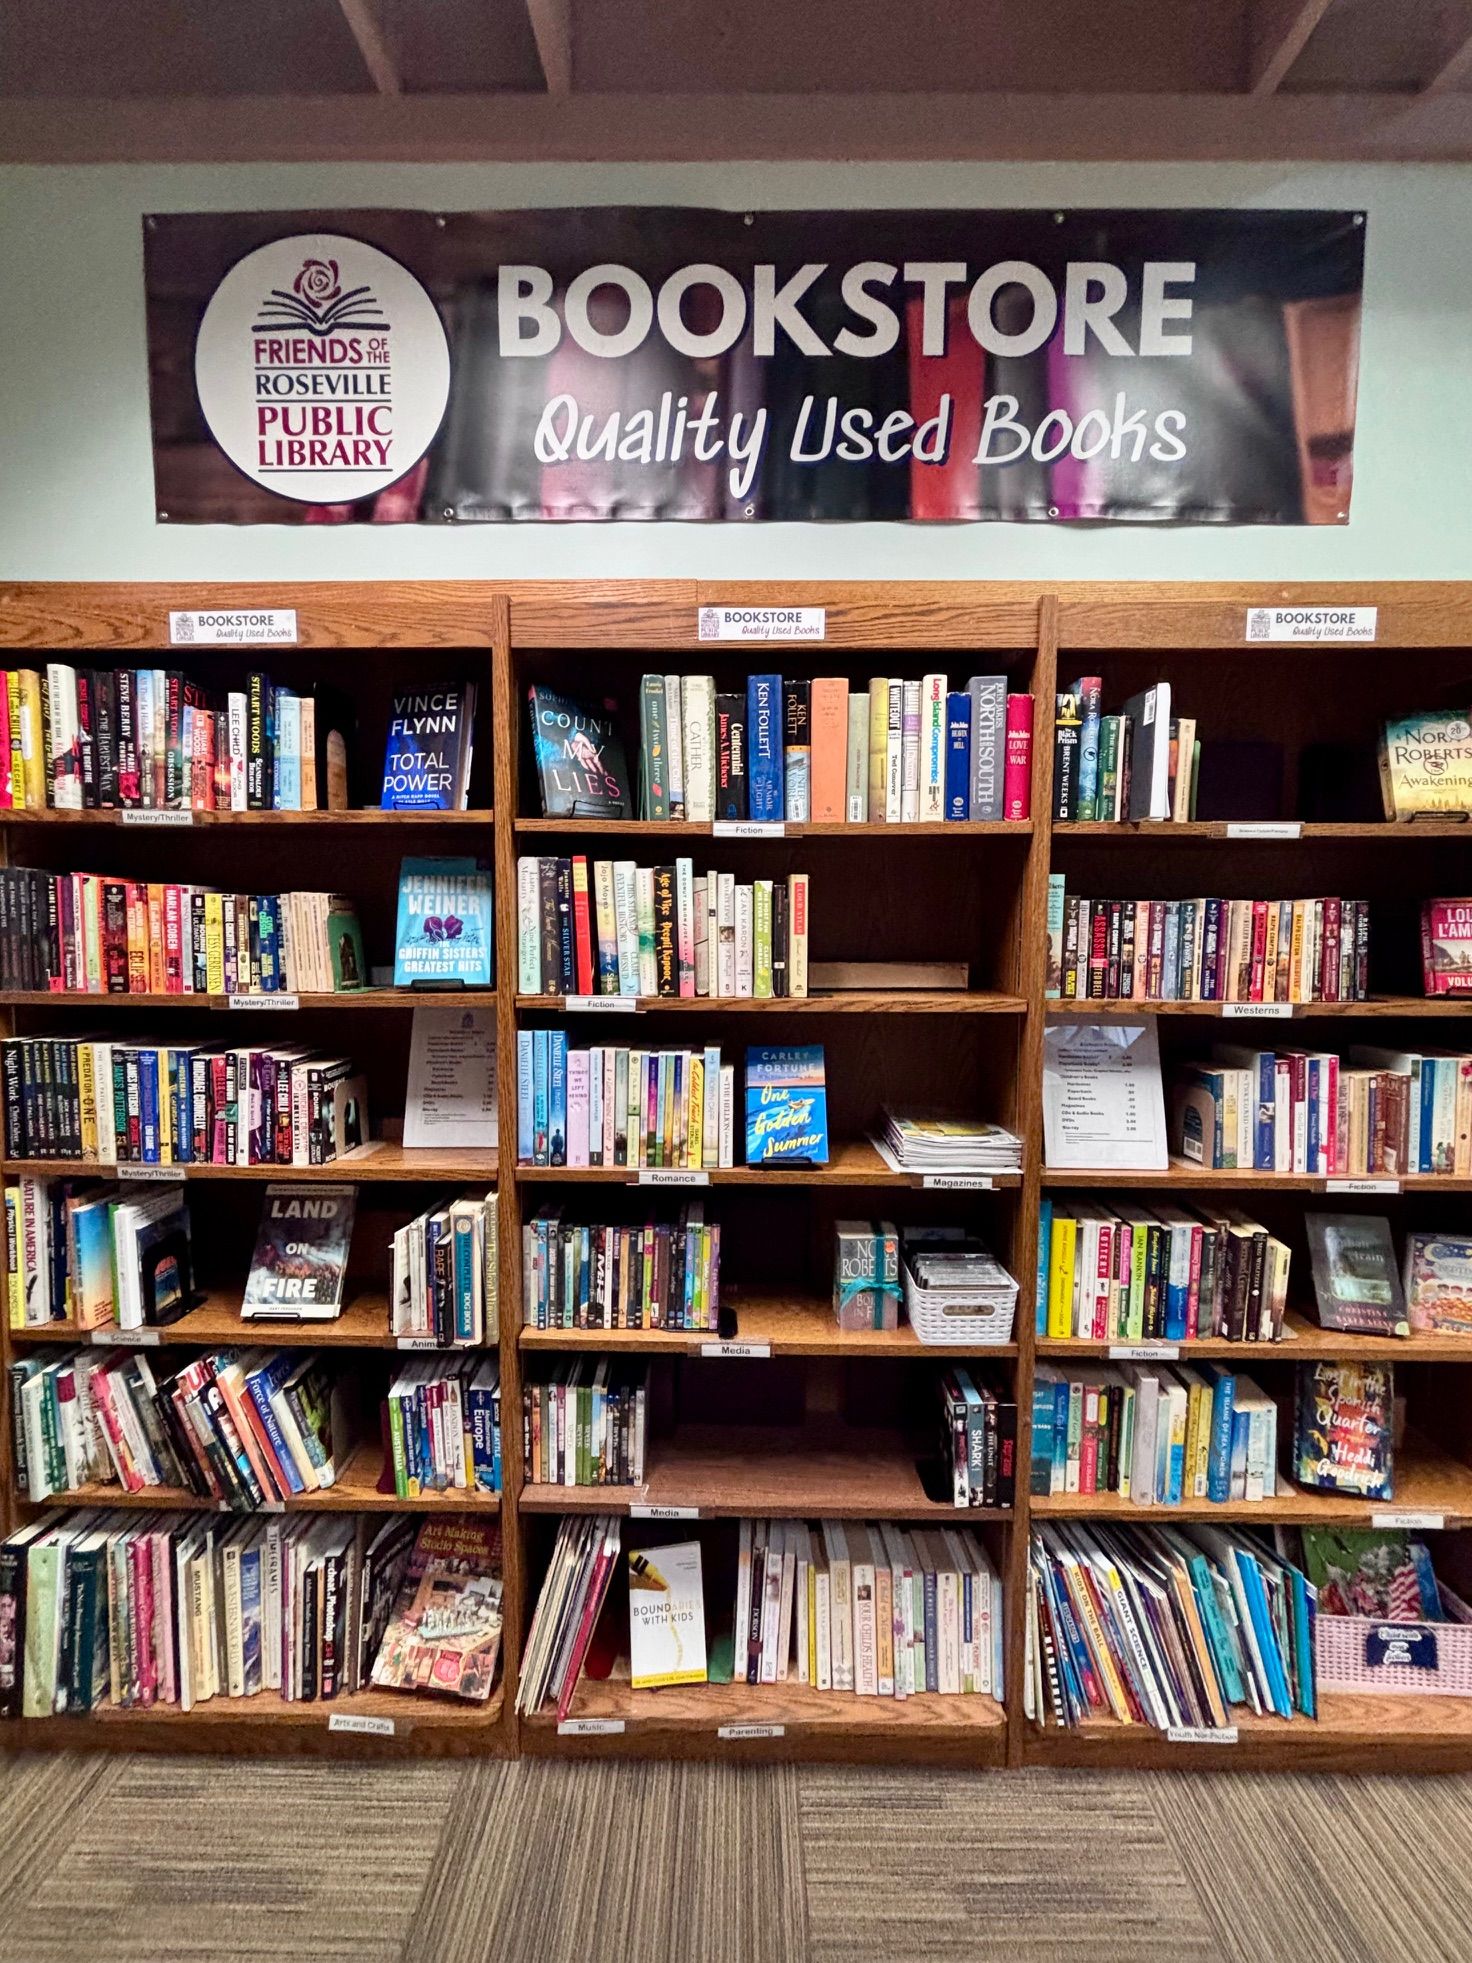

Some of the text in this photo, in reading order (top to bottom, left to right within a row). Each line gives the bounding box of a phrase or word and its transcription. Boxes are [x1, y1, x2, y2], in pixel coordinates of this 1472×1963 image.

[498, 260, 1196, 358] BOOKSTORE
[254, 338, 388, 364] FRIENDS OF
[367, 351, 390, 364] THE
[255, 374, 392, 395] ROSEVILLE
[258, 405, 393, 436] PUBLIC
[258, 439, 393, 467] LIBRARY
[534, 391, 1187, 499] Quality Used Books
[199, 616, 274, 626] BOOKSTORE
[725, 612, 802, 622] BOOKSTORE
[1276, 613, 1356, 624] BOOKSTORE
[216, 628, 291, 640] Quality Used Books
[742, 626, 770, 638] Quality
[795, 626, 819, 634] Books
[1293, 626, 1372, 638] Quality Used Books
[120, 673, 130, 737] STEVE BERRY
[170, 678, 178, 711] STUART
[393, 693, 458, 714] VINCE
[890, 687, 900, 728] WHITEOUT
[231, 709, 239, 725] LEE
[251, 676, 260, 753] STUART WOODS
[391, 716, 456, 736] FLYNN
[719, 713, 729, 738] James
[758, 683, 771, 758] KEN FOLLETT
[787, 694, 806, 735] KEN FOLLETT
[652, 701, 662, 783] one three
[930, 679, 942, 784] Long Island Compromise
[979, 685, 995, 803] NORTH SOUTH
[1058, 730, 1077, 738] Black
[690, 721, 702, 771] CATHER
[731, 723, 743, 775] Centennial
[391, 752, 449, 770] TOTAL
[1061, 746, 1071, 803] BRENT WEEKS
[383, 773, 452, 792] POWER
[553, 769, 621, 798] LIES
[126, 812, 189, 822] Mystery/Thriller
[402, 876, 488, 894] JENNIFER
[600, 865, 608, 882] Jojo
[408, 895, 481, 915] WEINER
[166, 890, 177, 949] HARLAN COBEN
[399, 948, 485, 960] GRIFFIN SISTERS
[562, 928, 570, 955] SILVER
[129, 951, 145, 984] ECLIPSE
[208, 934, 221, 991] TESS GERRITSEN
[404, 961, 455, 972] GREATEST
[1093, 968, 1101, 997] TED BELL
[233, 998, 295, 1007] Mystery/Thriller
[588, 1001, 615, 1009] Fiction
[1234, 1006, 1280, 1014] Westerns
[521, 1041, 529, 1077] DANIELLE
[553, 1035, 563, 1067] DANIELLE
[761, 1051, 810, 1061] CARLEY
[5, 1050, 20, 1101] Night Work
[756, 1063, 814, 1074] FORTUNE
[82, 1053, 95, 1124] PREDATOR ONE
[114, 1065, 126, 1132] JAMES PATTERSON
[127, 1063, 139, 1116] JAMES PATTERSON
[193, 1061, 206, 1129] MICHAEL CONNELLY
[278, 1080, 289, 1112] LEE CHILD
[760, 1085, 790, 1105] One
[754, 1108, 812, 1135] Golden
[765, 1132, 824, 1158] Summer
[121, 1169, 182, 1178] Mystery/Thriller
[652, 1174, 696, 1183] Romance
[933, 1178, 983, 1188] Magazines
[270, 1200, 339, 1218] LAND
[24, 1179, 36, 1272] NATURE IN AMERICA
[7, 1208, 17, 1272] Physics Workbook
[285, 1243, 310, 1255] ON
[486, 1242, 496, 1260] The
[1099, 1229, 1108, 1274] LOTTERY
[436, 1249, 445, 1276] RARE
[262, 1278, 317, 1299] FIRE
[721, 1346, 750, 1355] Media
[1131, 1350, 1158, 1358] Fiction
[250, 1378, 282, 1446] Force of Nature
[1328, 1387, 1381, 1414] Spanish
[473, 1409, 484, 1449] Europe
[1222, 1423, 1229, 1432] OF
[1316, 1407, 1382, 1435] Quarter
[393, 1431, 402, 1471] AUSTRALIA
[971, 1430, 982, 1467] SHARK
[1331, 1442, 1376, 1467] Heddi
[1219, 1450, 1227, 1477] WOMEN
[1316, 1461, 1387, 1488] Goodrich
[650, 1509, 679, 1517] Media
[420, 1538, 453, 1551] Studio
[424, 1524, 485, 1543] Art Making
[193, 1570, 202, 1616] MUSTANG
[324, 1568, 337, 1641] cheat Photoshop
[642, 1612, 694, 1625] WITH KIDS
[1074, 1572, 1104, 1648] KIDS ON THE BALL
[751, 1607, 761, 1641] DOBSON
[1117, 1591, 1148, 1670] GIANT SCIENCE
[861, 1601, 873, 1687] YOUR HEALTH
[578, 1723, 605, 1731] Music
